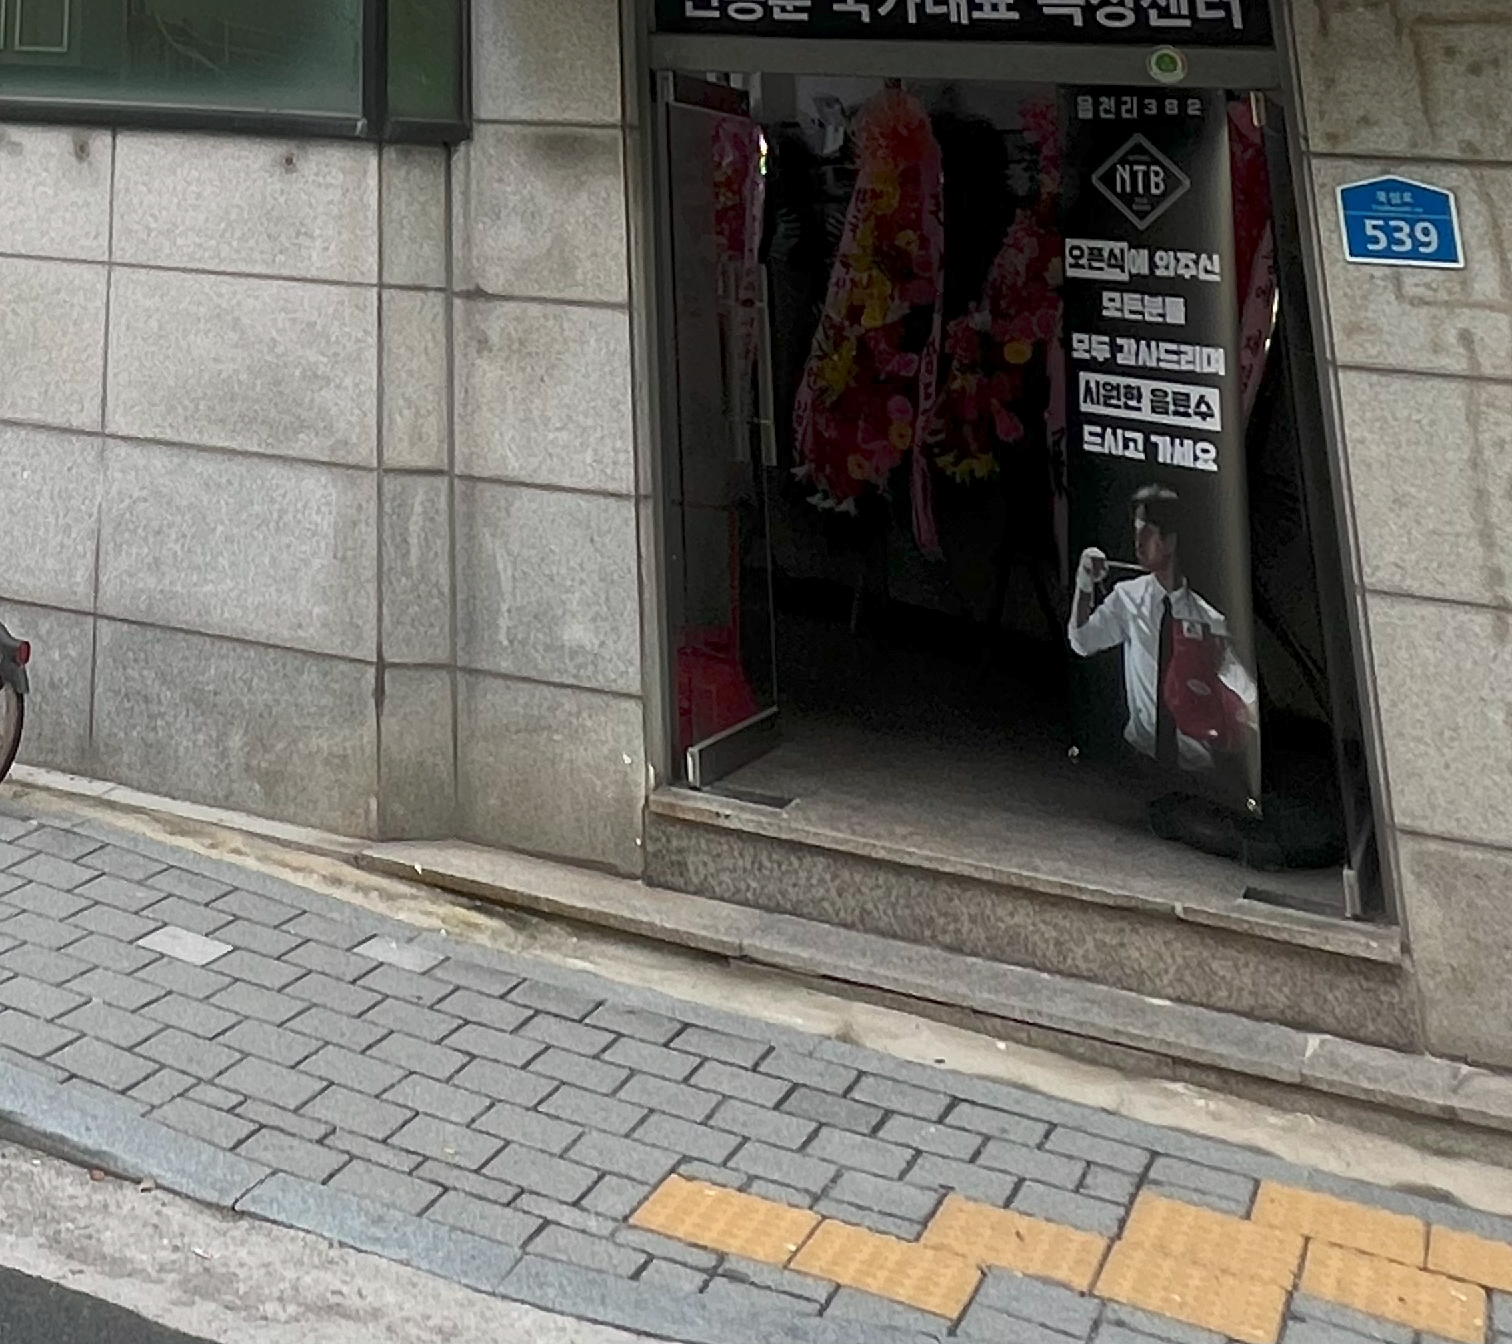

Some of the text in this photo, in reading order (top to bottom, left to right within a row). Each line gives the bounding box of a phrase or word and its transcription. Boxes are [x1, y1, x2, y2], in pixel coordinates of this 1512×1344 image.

[1115, 164, 1166, 196] NTB
[1363, 218, 1438, 254] 539
[1067, 244, 1222, 282] 오픈식에 와주신
[1071, 331, 1226, 376] 모두 감사드리며
[1082, 379, 1216, 422] 시원한 음료수
[1082, 424, 1219, 472] 드시고 가세요
